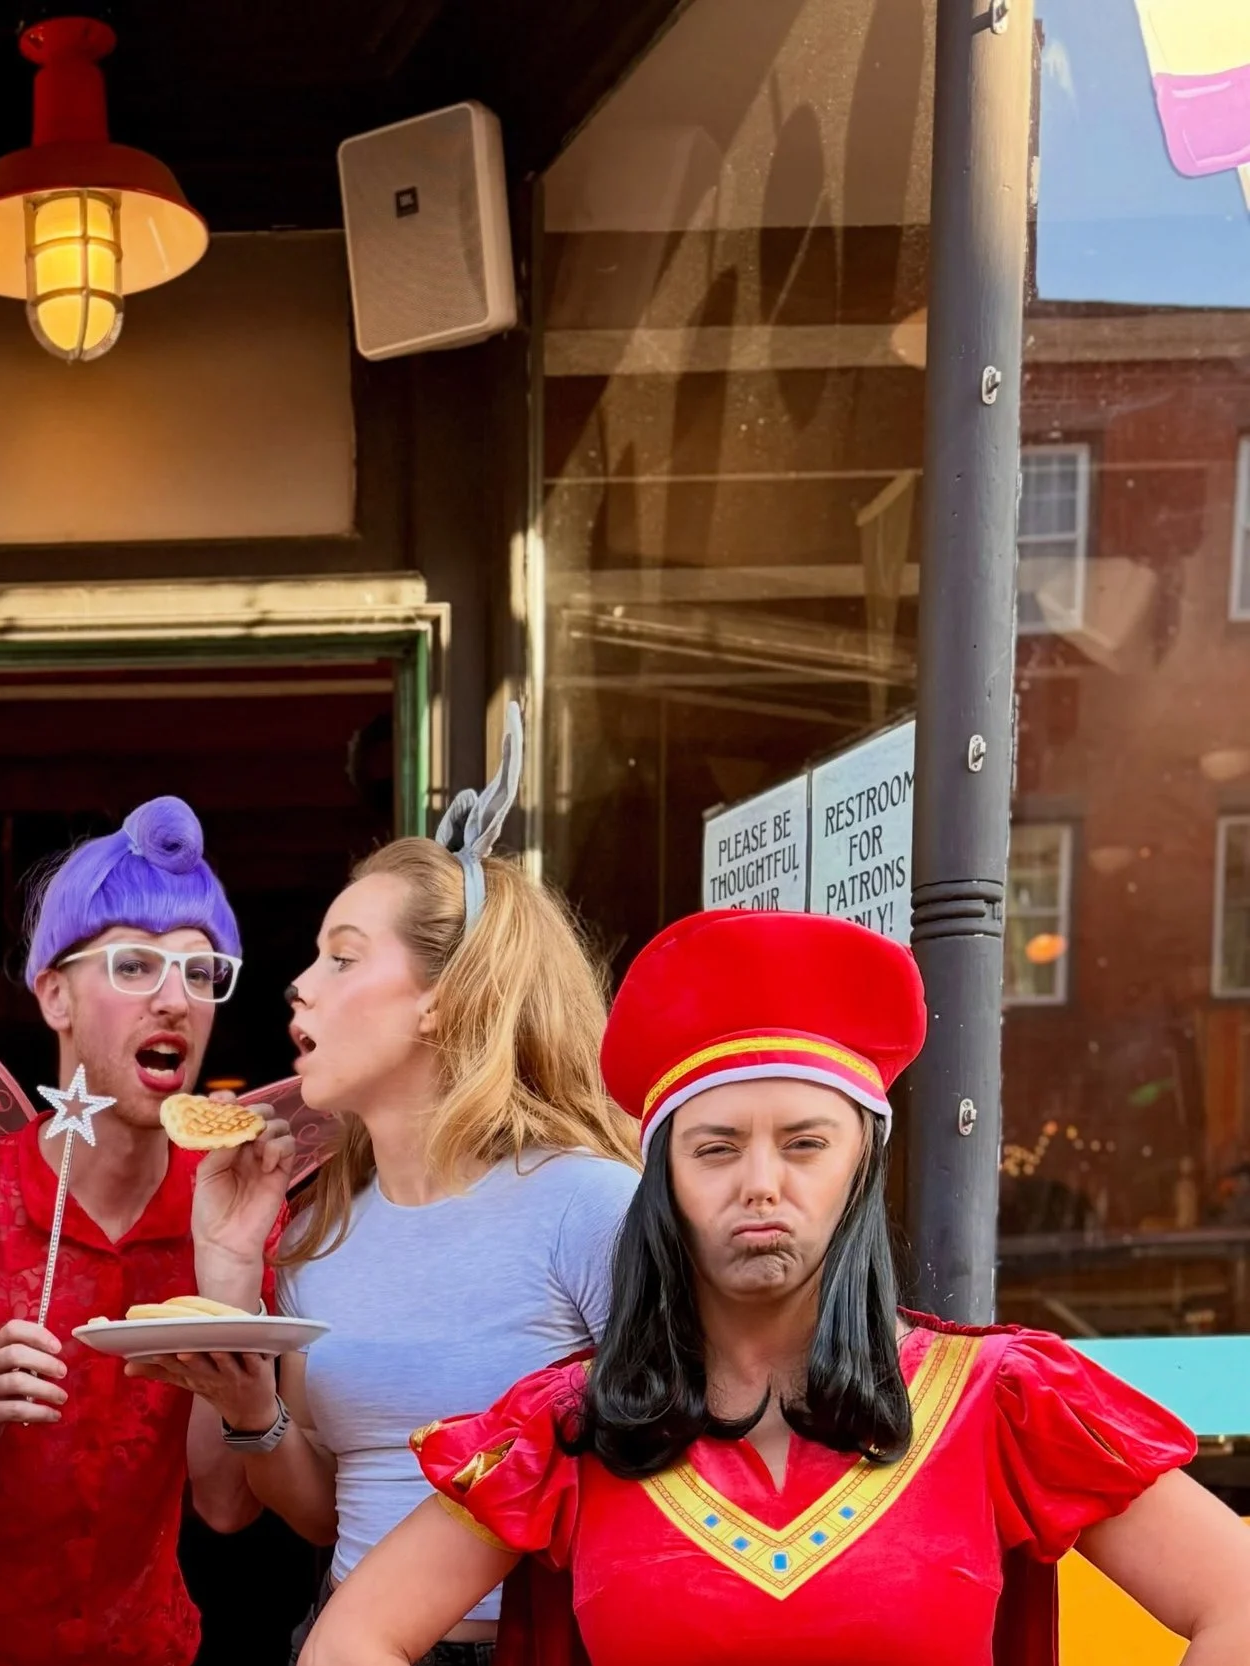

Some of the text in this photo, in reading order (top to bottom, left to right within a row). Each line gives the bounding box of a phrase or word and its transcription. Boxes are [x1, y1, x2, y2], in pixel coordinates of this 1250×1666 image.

[719, 810, 791, 866] PLEASE BE
[849, 825, 883, 866] FOR
[710, 843, 799, 903] THOUGHTFUL
[827, 856, 905, 914] PATRONS
